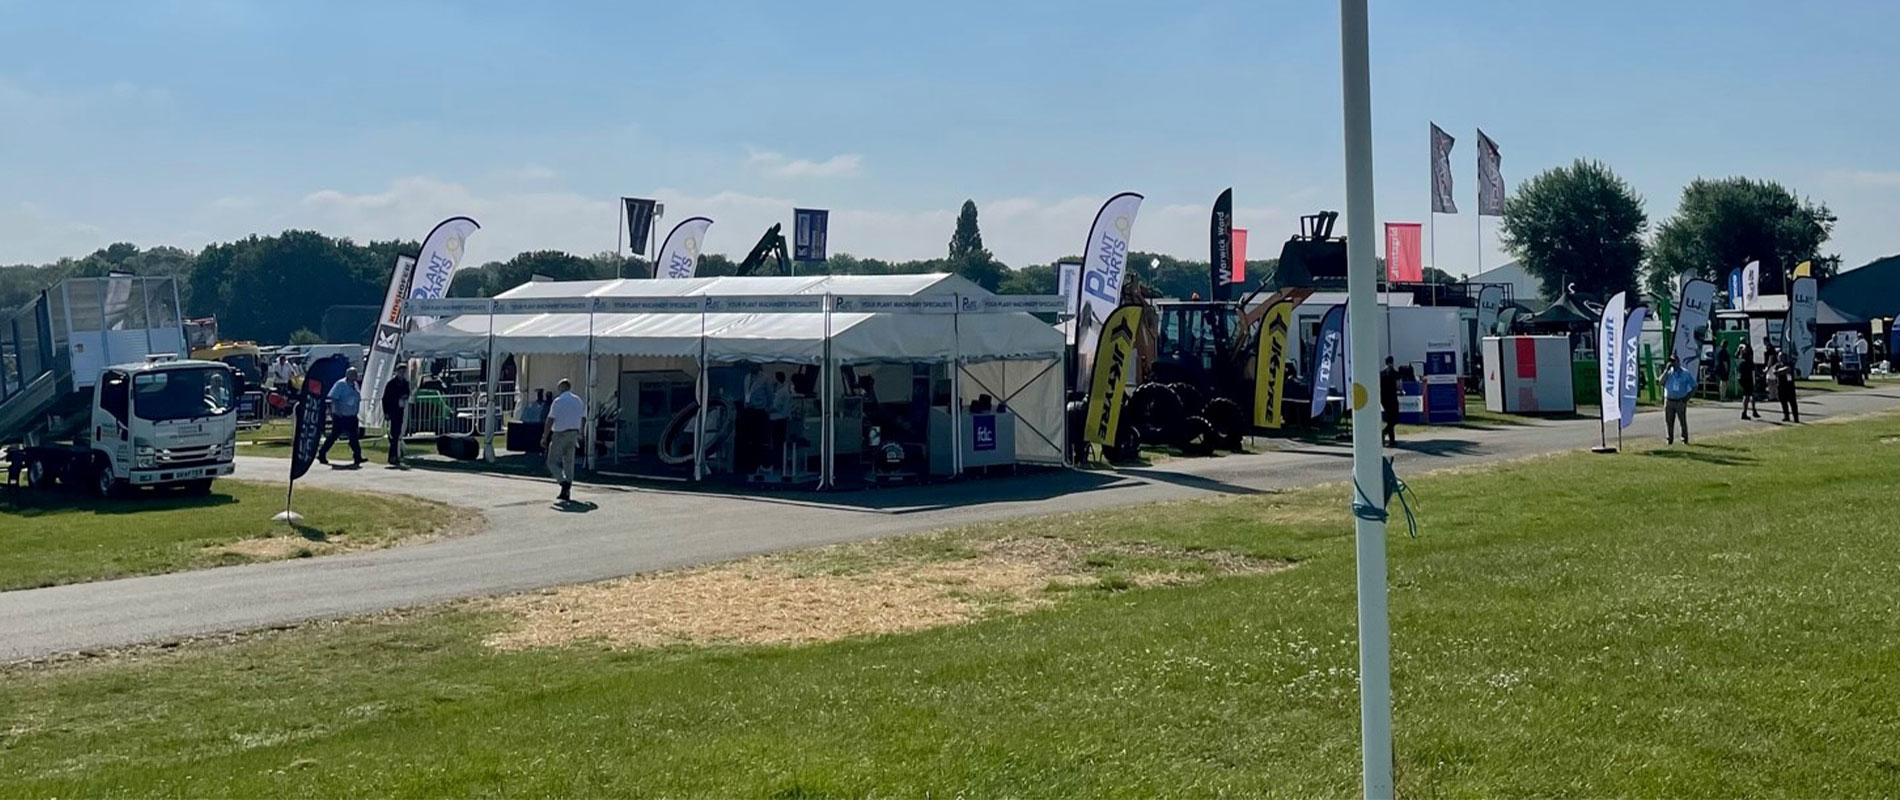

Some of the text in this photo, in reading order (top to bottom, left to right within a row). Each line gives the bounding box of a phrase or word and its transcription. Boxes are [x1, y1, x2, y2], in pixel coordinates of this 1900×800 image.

[669, 251, 682, 279] ANT
[1084, 232, 1116, 304] PLANT
[1106, 239, 1126, 291] PARTS
[1217, 211, 1231, 286] Warwick Ward
[1320, 332, 1336, 382] TEXA
[1605, 316, 1614, 397] Autocraft
[1626, 337, 1638, 391] TEXA
